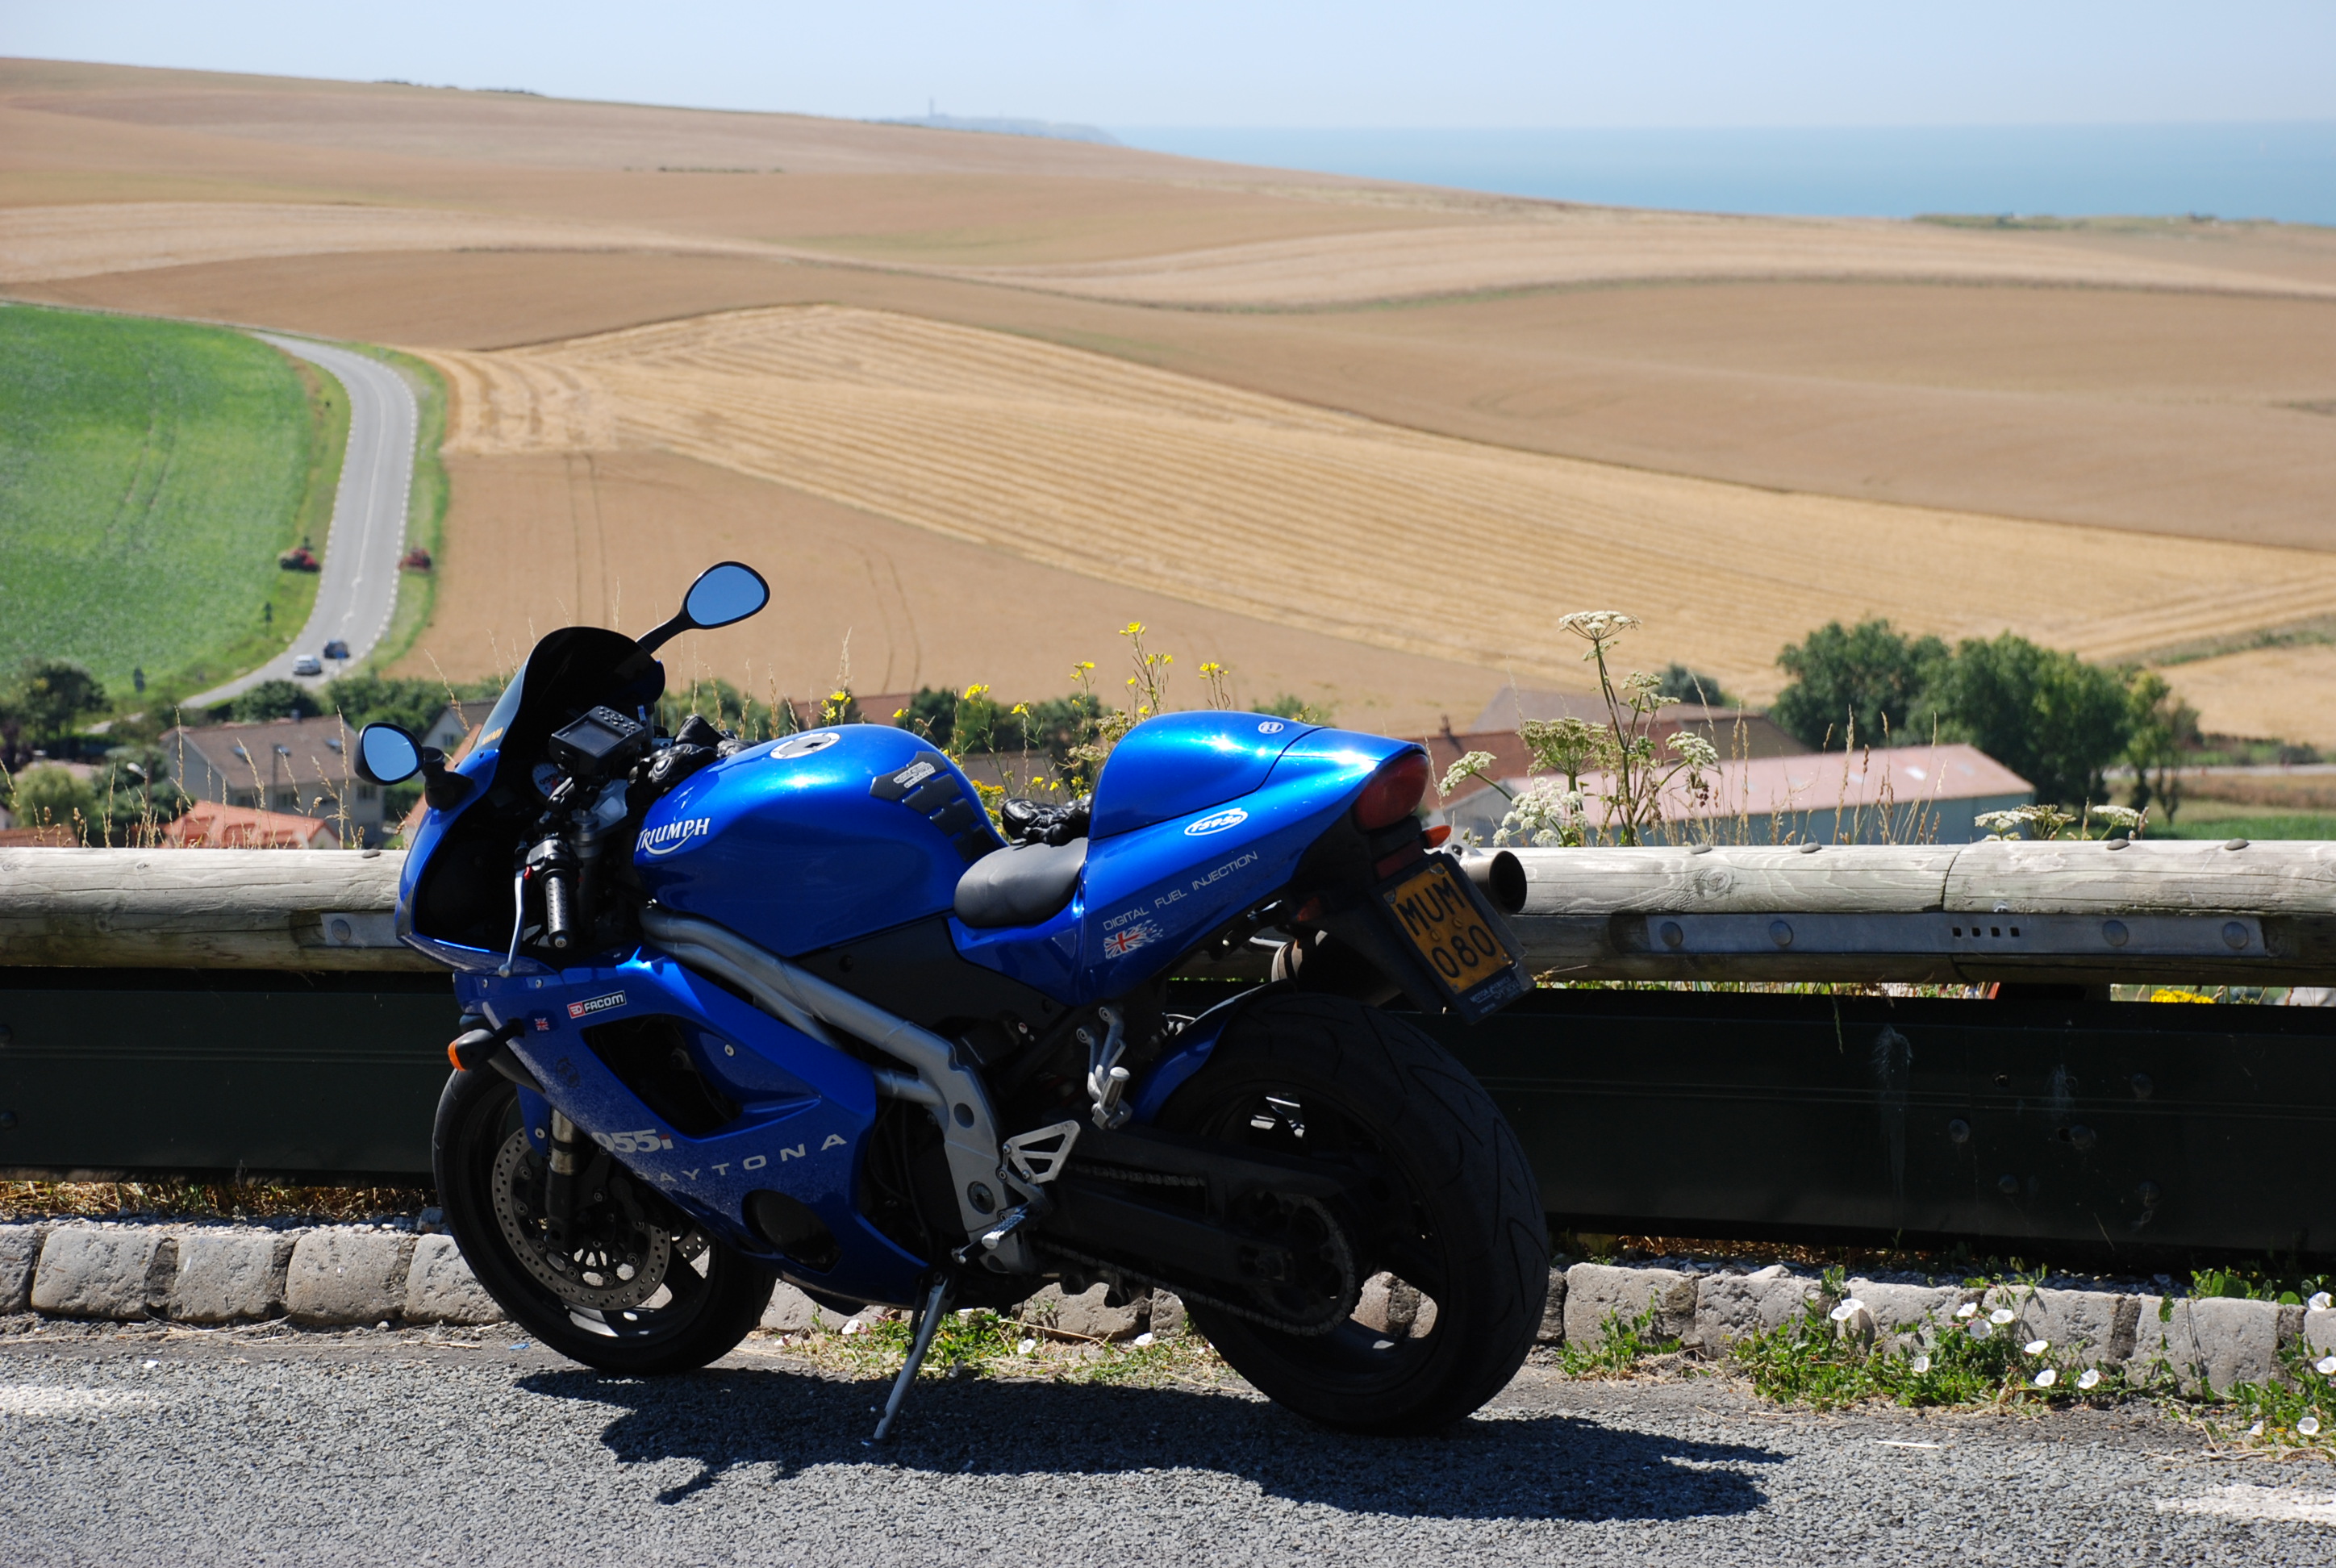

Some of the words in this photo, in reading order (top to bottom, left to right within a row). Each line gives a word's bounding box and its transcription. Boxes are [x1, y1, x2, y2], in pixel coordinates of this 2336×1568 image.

[636, 817, 711, 855] TRIUMPH
[1102, 906, 1150, 931] DIGITAL
[1154, 889, 1188, 909] FUEL
[1191, 850, 1258, 891] INJECTION
[1396, 877, 1466, 936] MUM
[1432, 924, 1496, 978] 080
[583, 993, 624, 1012] FACOM
[590, 1128, 674, 1153] 955i
[635, 1133, 848, 1182] DAYTONA
